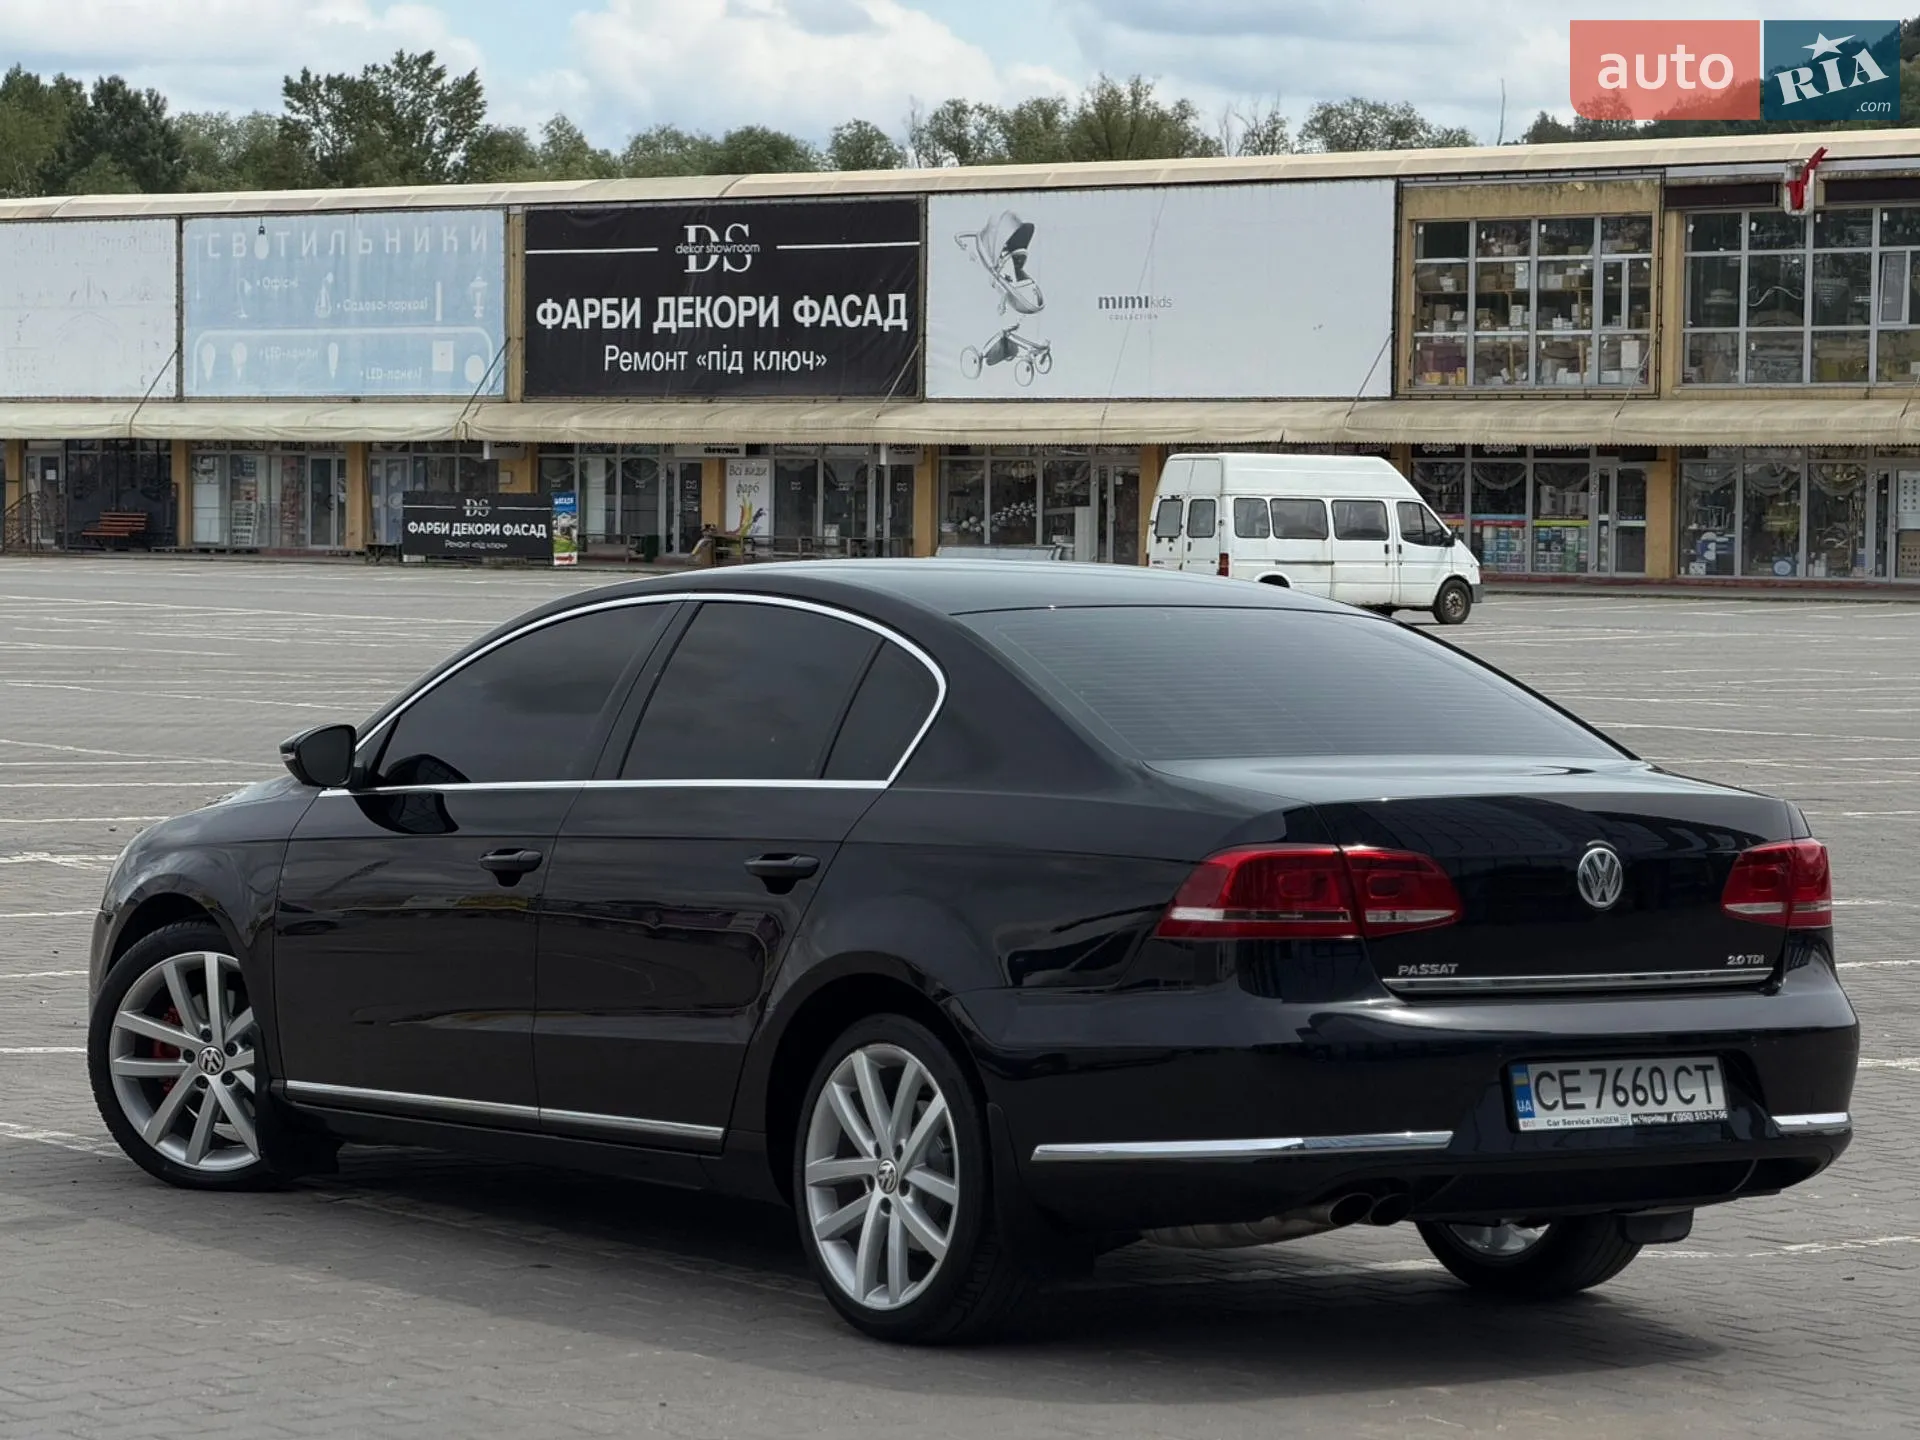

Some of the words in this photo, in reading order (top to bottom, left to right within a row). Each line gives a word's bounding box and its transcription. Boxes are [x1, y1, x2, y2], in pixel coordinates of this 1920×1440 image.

[675, 243, 704, 254] dekor
[705, 243, 760, 253] showroom
[683, 223, 752, 272] DS
[536, 297, 641, 329] ФАРБИ
[653, 296, 779, 334] ДЕКОРИ
[792, 293, 908, 332] ФАСАД
[604, 345, 688, 372] Ремонт
[696, 344, 744, 374] «під
[753, 350, 827, 372] ключ»
[407, 521, 450, 535] ФАРБИ
[451, 522, 500, 537] ДЕКОРИ
[502, 523, 547, 538] ФАСАД
[1398, 963, 1459, 976] PASSAT
[1516, 1101, 1532, 1112] UA
